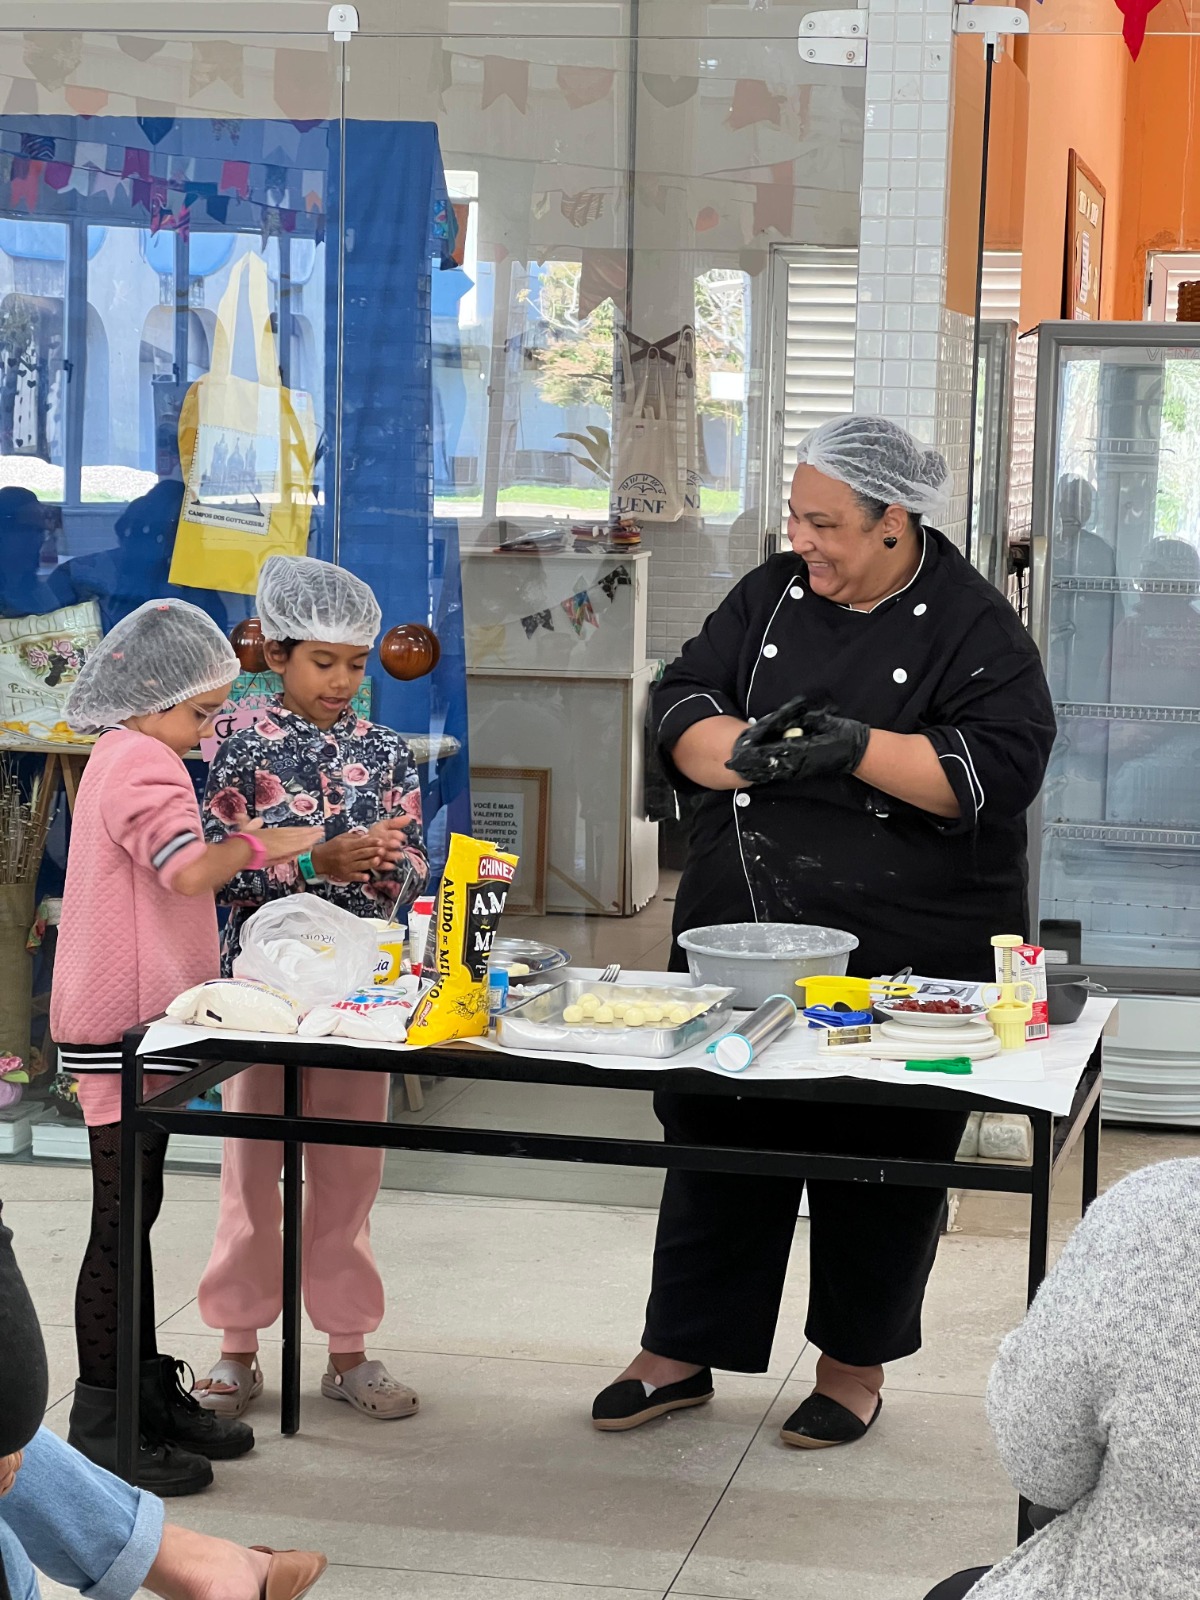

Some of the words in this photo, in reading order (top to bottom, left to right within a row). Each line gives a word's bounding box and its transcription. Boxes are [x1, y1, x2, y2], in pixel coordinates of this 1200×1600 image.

[188, 509, 212, 519] CAMPOS
[617, 496, 667, 514] UENF
[442, 876, 454, 932] AMIDO
